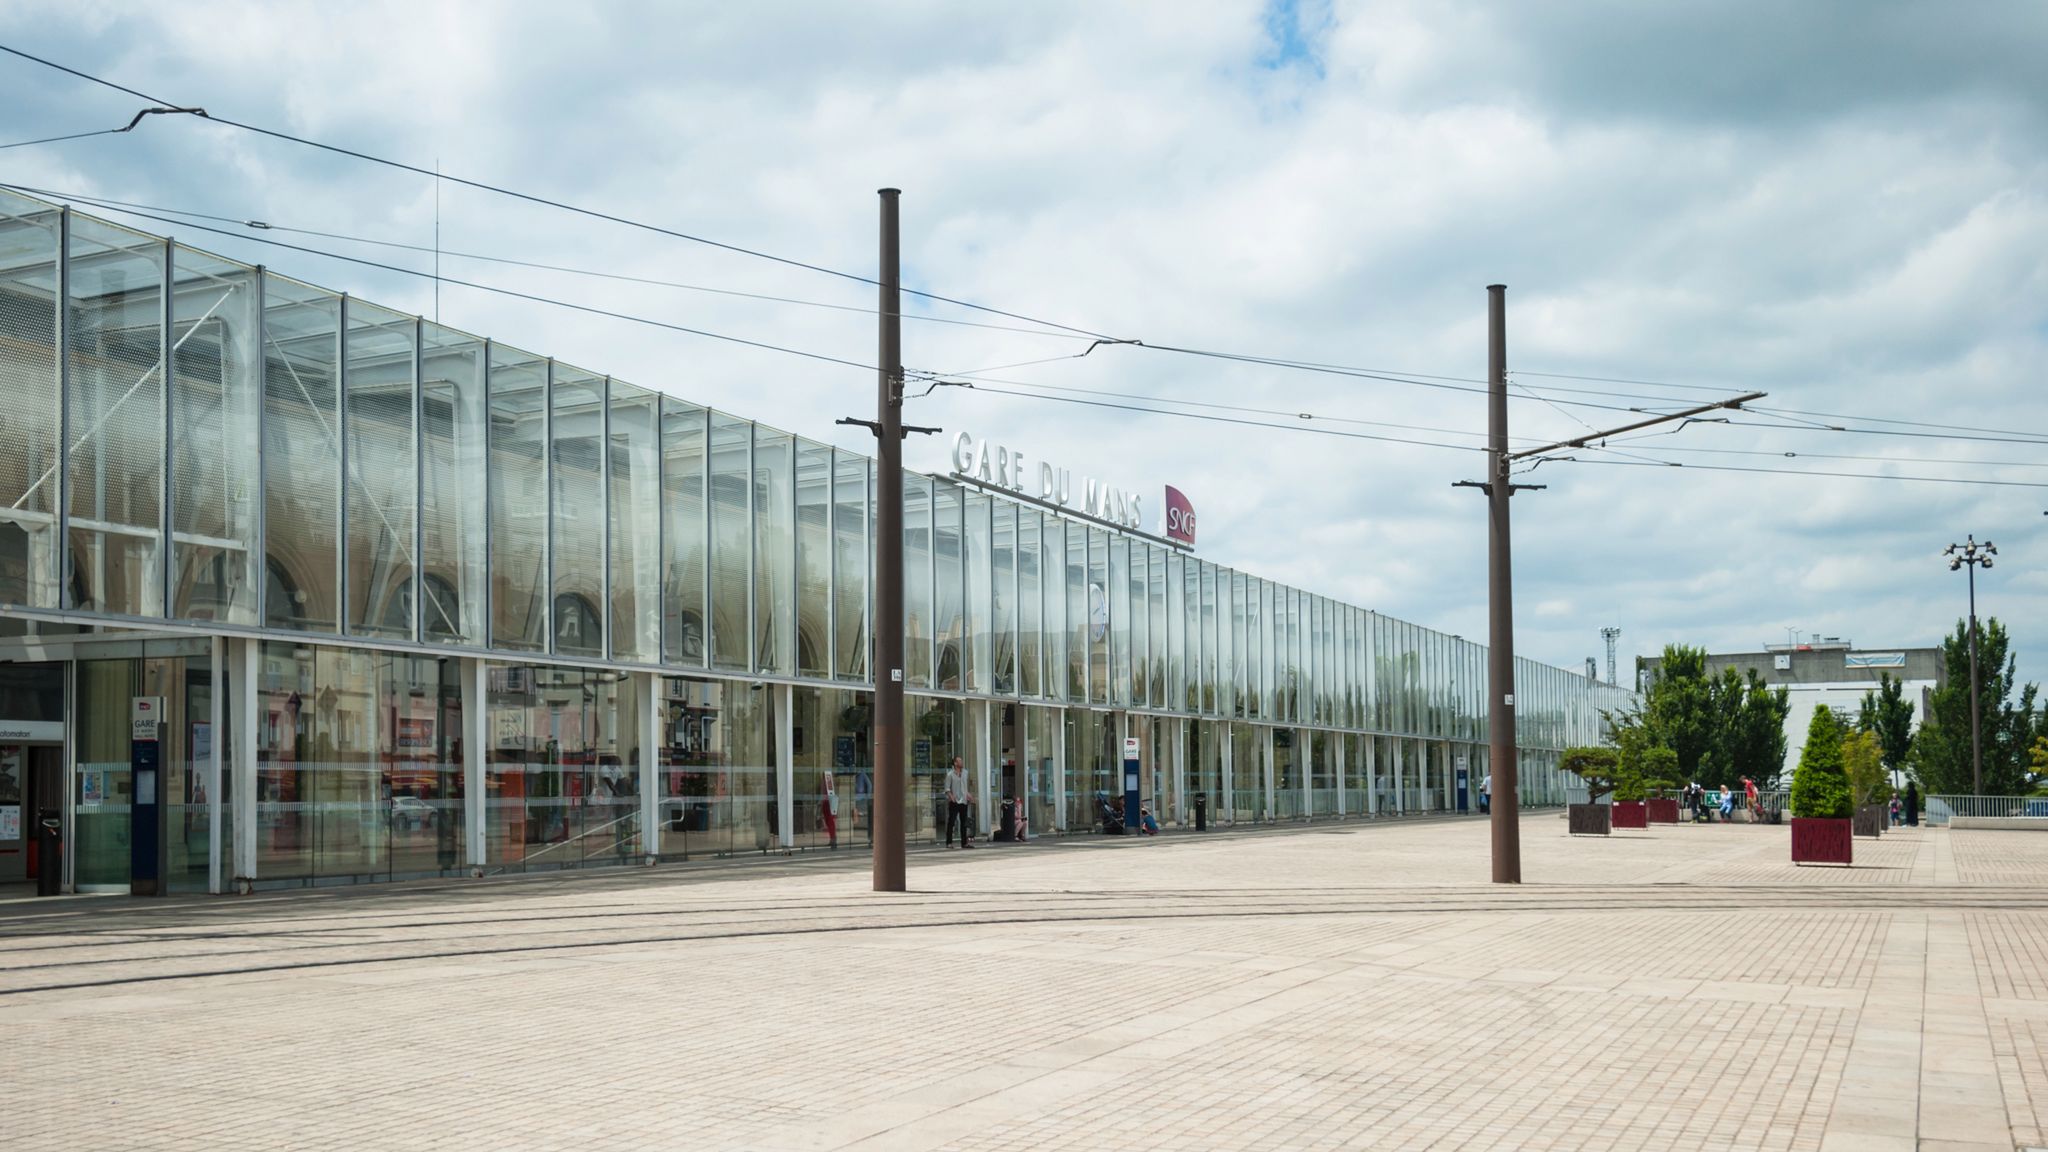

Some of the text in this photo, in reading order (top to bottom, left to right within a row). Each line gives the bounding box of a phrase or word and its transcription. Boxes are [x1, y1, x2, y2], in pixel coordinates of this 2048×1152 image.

[952, 431, 1141, 529] GARE DU MANS
[1168, 507, 1196, 537] SNCF
[135, 719, 156, 728] GARE
